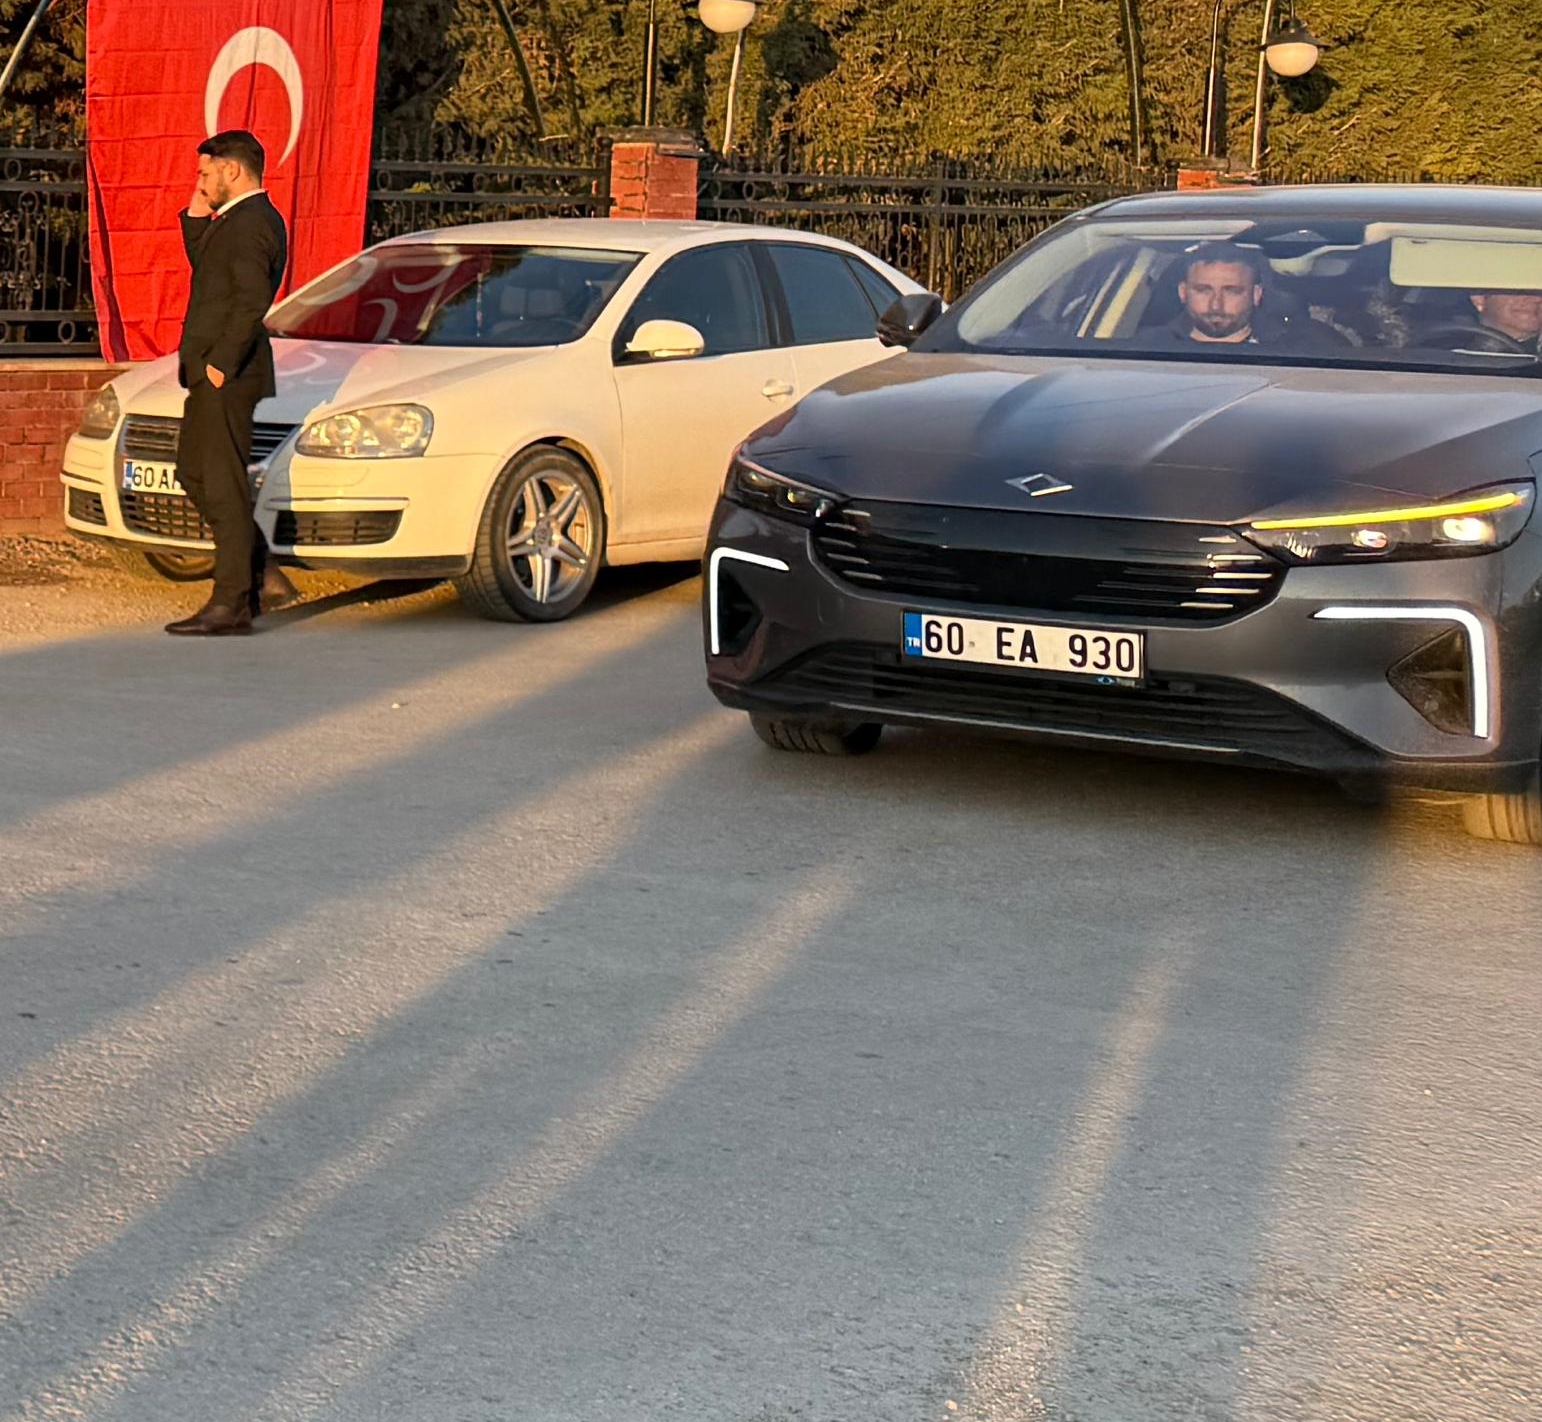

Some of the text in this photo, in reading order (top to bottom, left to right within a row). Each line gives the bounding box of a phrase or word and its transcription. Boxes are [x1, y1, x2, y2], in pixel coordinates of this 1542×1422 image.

[133, 466, 155, 488] 60
[924, 620, 964, 656] 60
[996, 626, 1038, 664] EA
[1068, 634, 1135, 673] 930
